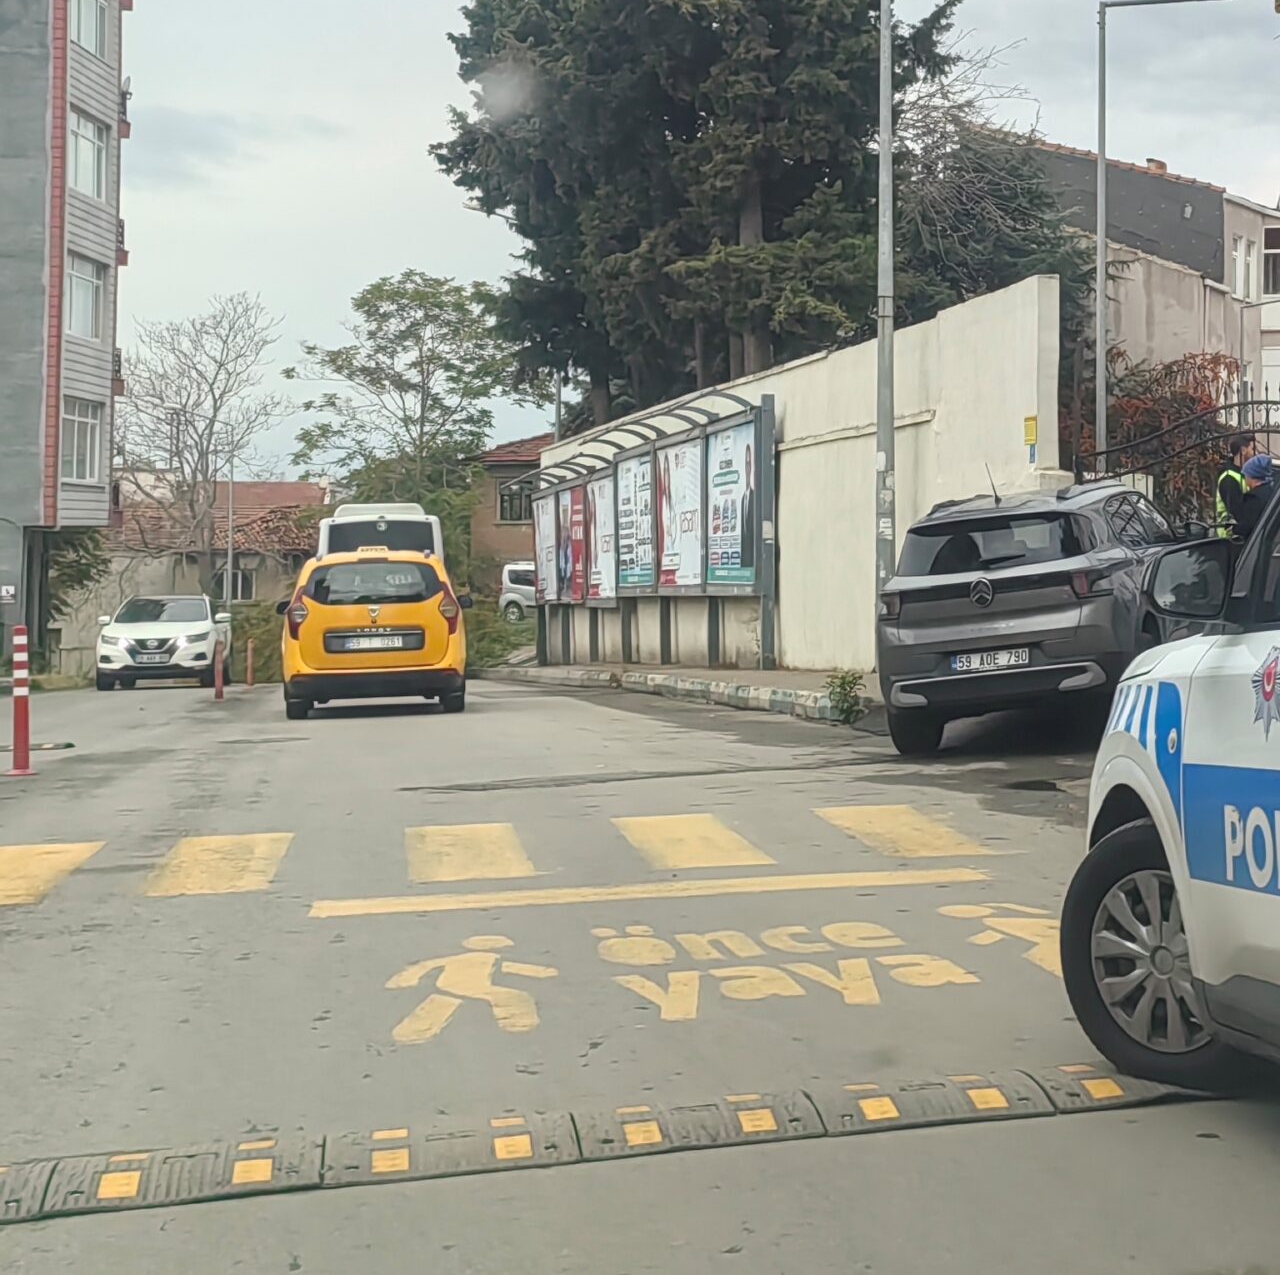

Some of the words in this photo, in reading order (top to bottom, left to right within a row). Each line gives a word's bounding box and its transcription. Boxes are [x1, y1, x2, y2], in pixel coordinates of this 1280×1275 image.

[958, 655, 972, 669] 59
[979, 652, 1000, 667] AOE
[1006, 649, 1028, 664] 790
[590, 921, 907, 967] önce
[611, 953, 982, 1022] yaya
